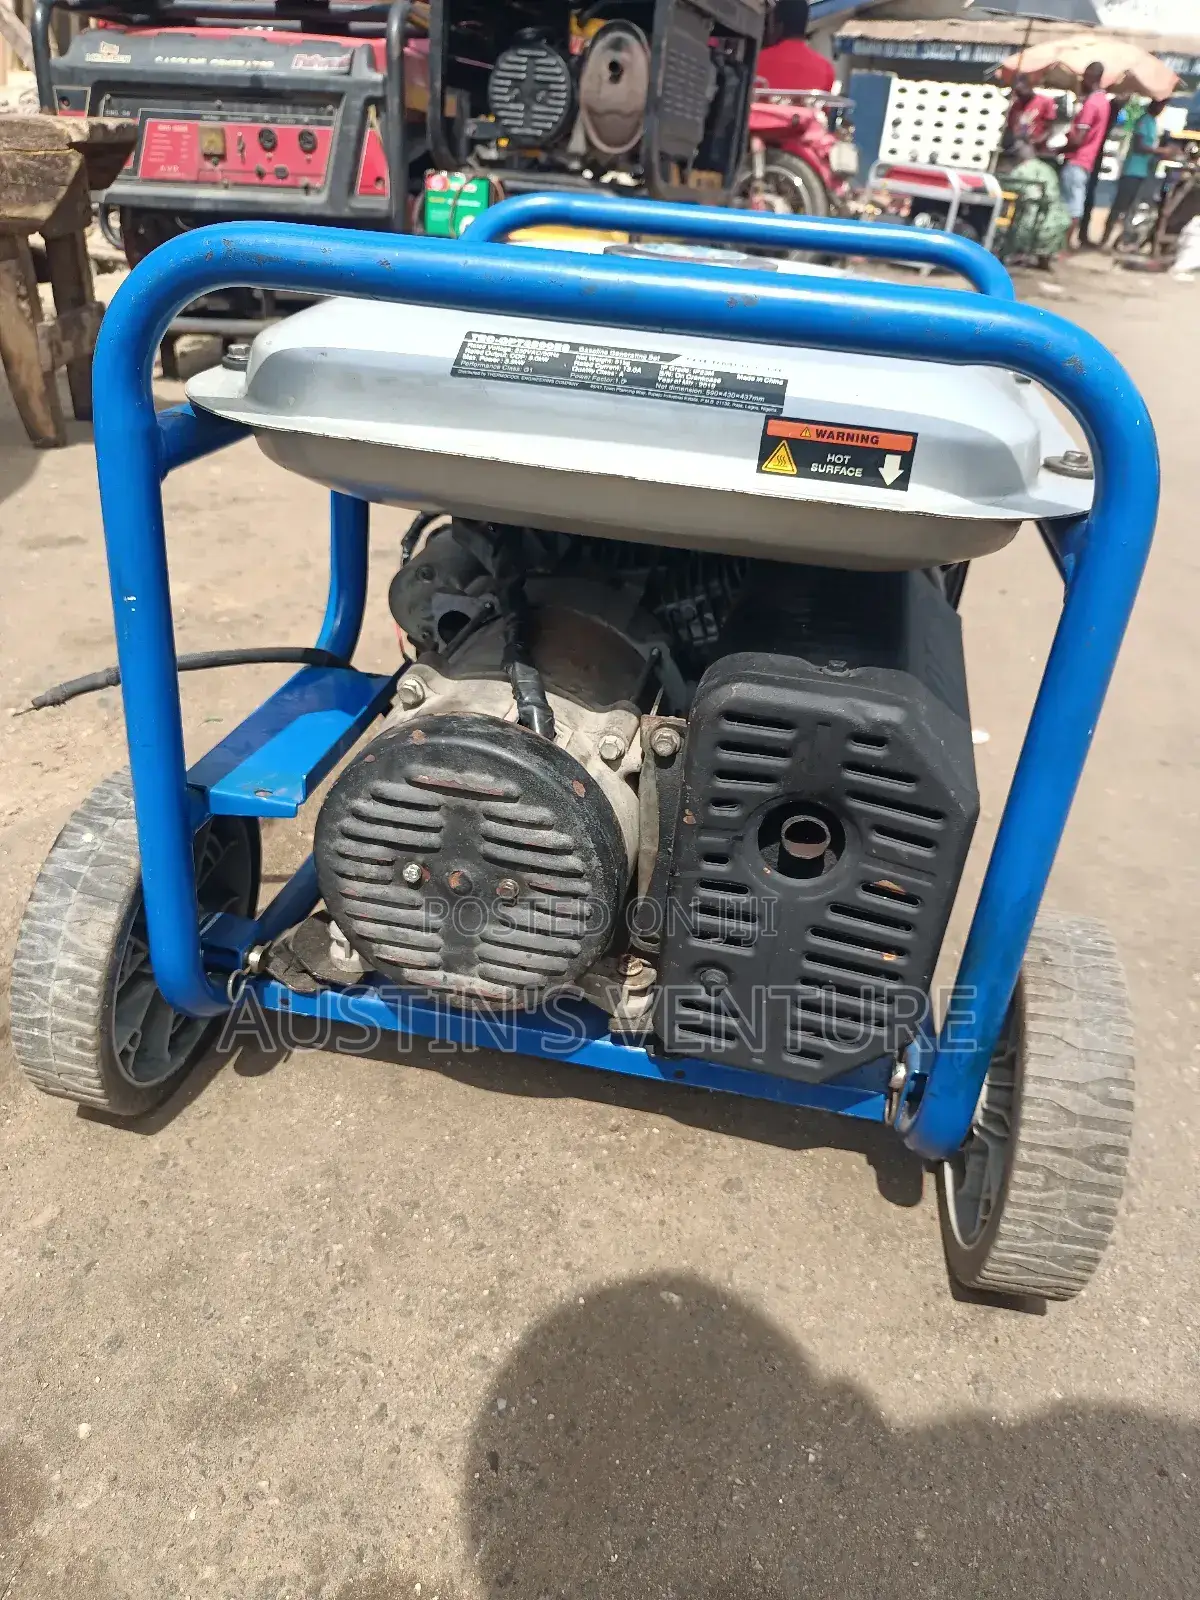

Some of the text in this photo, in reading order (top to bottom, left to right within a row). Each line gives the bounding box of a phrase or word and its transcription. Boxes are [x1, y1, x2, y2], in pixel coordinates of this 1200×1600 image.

[815, 428, 880, 445] WARNING
[826, 453, 851, 465] HOT
[810, 463, 863, 477] SURFACE
